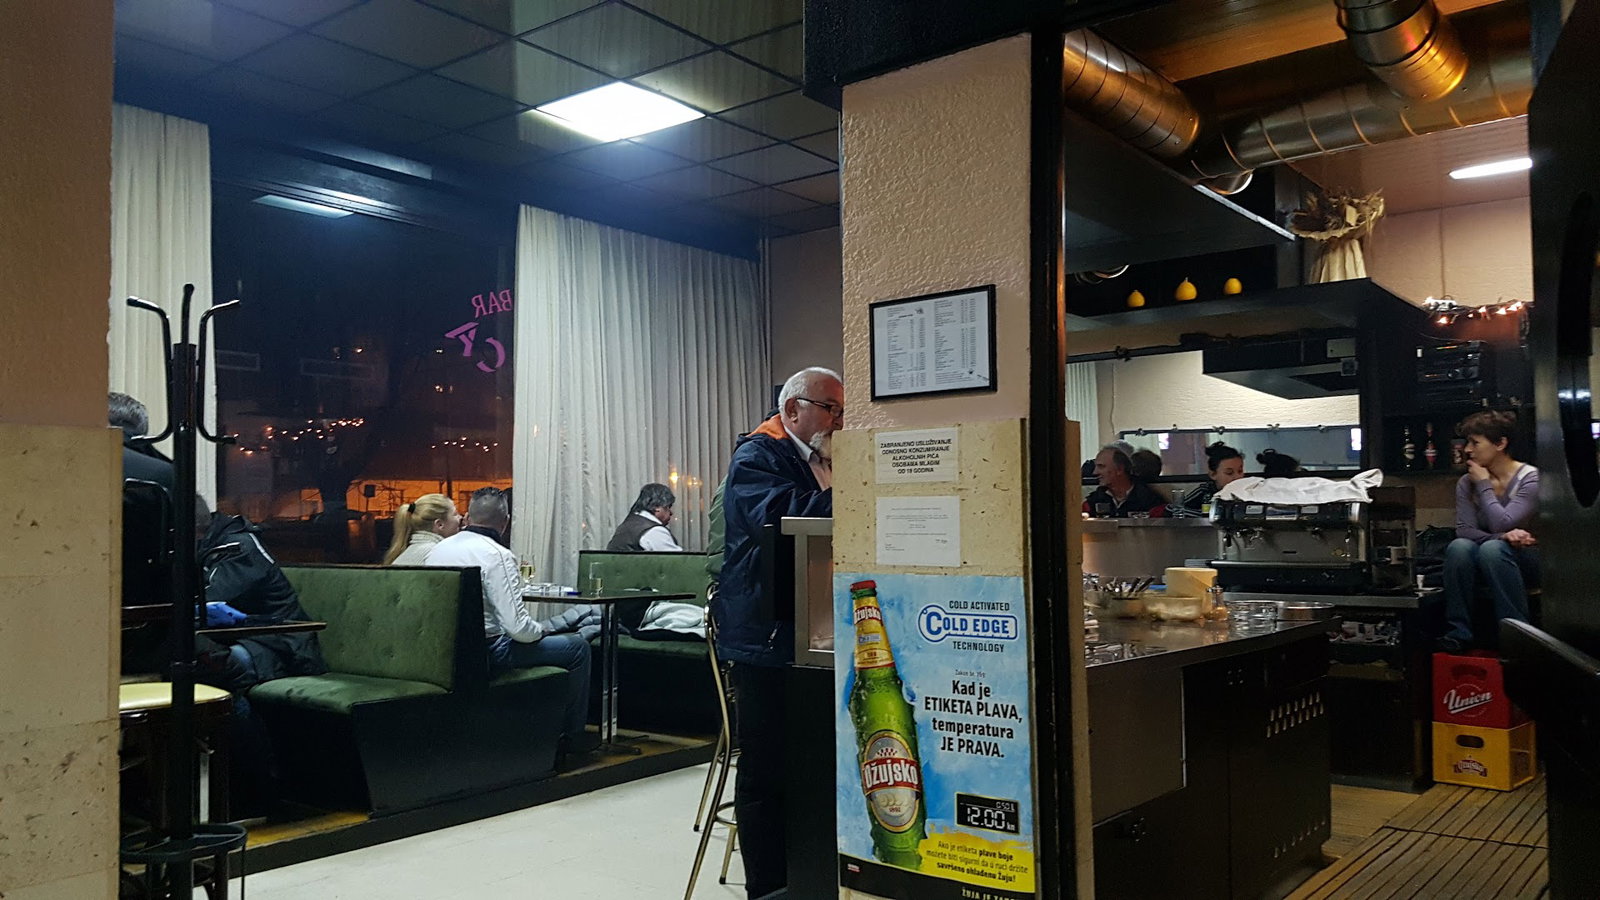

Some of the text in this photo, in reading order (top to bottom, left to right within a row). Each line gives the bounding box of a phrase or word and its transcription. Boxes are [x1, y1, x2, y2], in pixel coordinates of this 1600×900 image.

[949, 600, 1010, 611] COLD ACTIVATED
[926, 611, 1010, 635] COLD EDGE
[953, 641, 1005, 653] TECHNOLOGY
[952, 680, 991, 700] Kad je
[1443, 689, 1492, 711] Union
[924, 696, 1022, 723] ETIKETA PLAVA,
[932, 717, 1014, 739] temperatura
[941, 736, 1005, 758] JE PRAVA.
[864, 760, 919, 788] Ožujsko
[967, 806, 1005, 829] 12.00
[938, 841, 949, 849] Ako
[979, 849, 996, 858] plave
[997, 851, 1013, 862] boje
